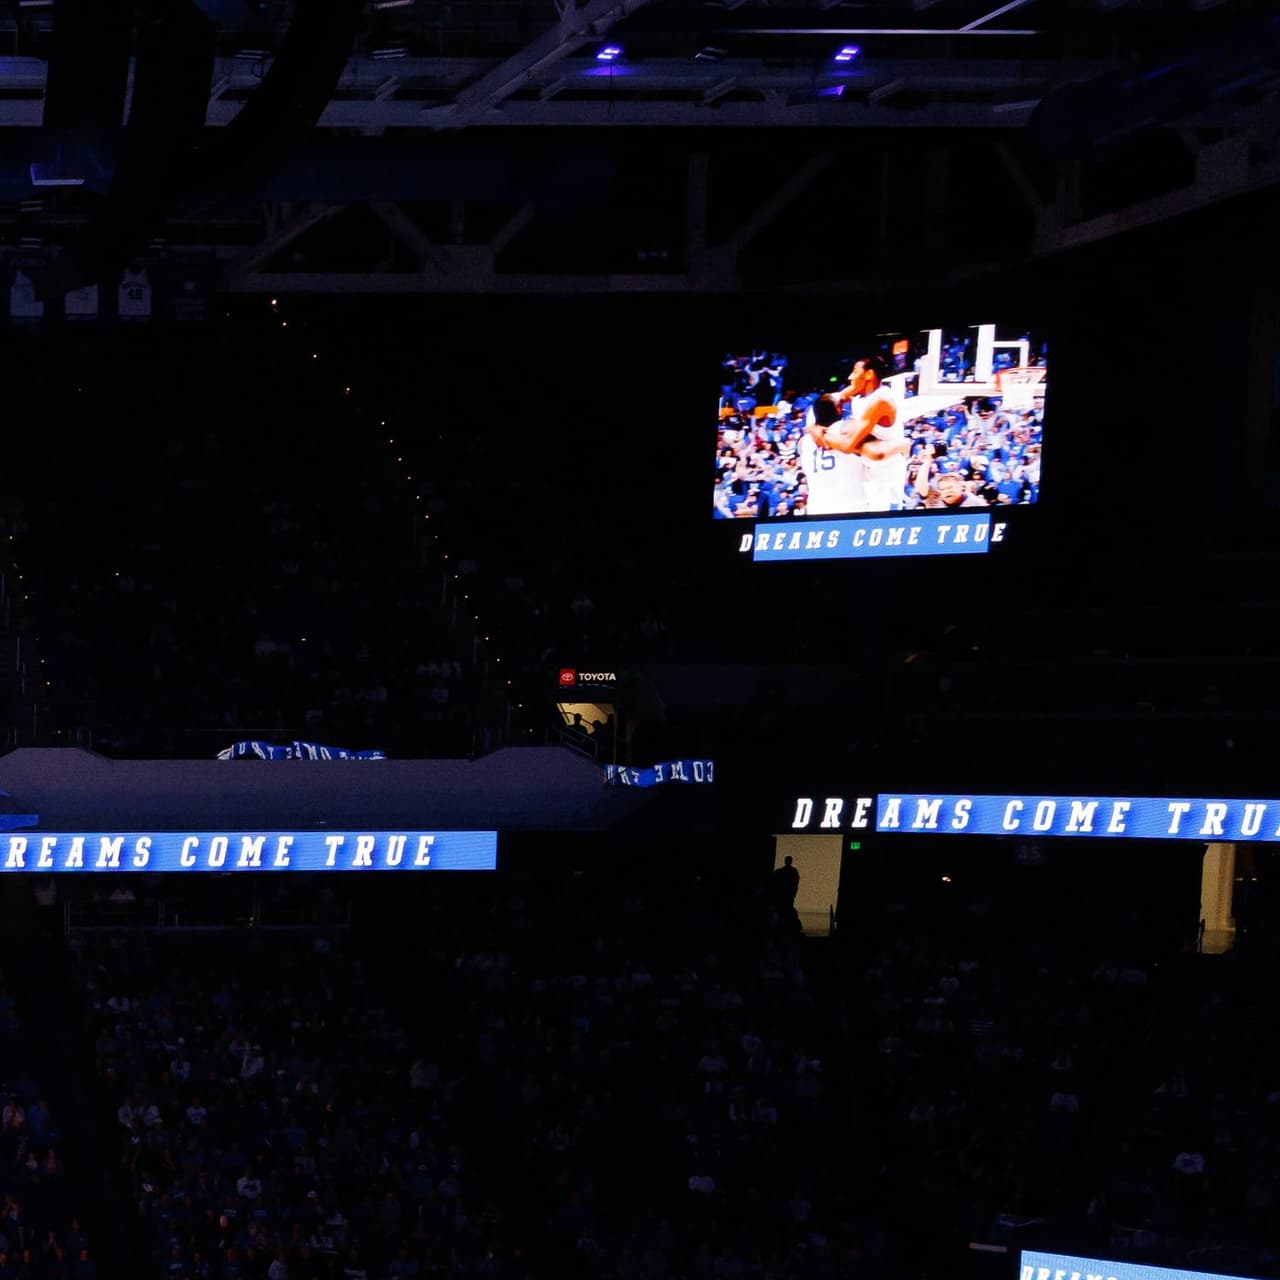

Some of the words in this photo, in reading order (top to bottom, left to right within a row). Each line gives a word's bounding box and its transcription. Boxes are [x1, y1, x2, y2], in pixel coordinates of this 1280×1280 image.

[739, 529, 840, 552] DREAMS
[852, 526, 922, 547] COME
[937, 522, 1007, 544] TRUE
[578, 672, 617, 681] TOYOTA
[791, 795, 973, 831] DREAMS
[1002, 798, 1131, 834] COME
[1167, 801, 1280, 838] TRU
[180, 835, 294, 867] COME
[325, 835, 436, 866] TRUE
